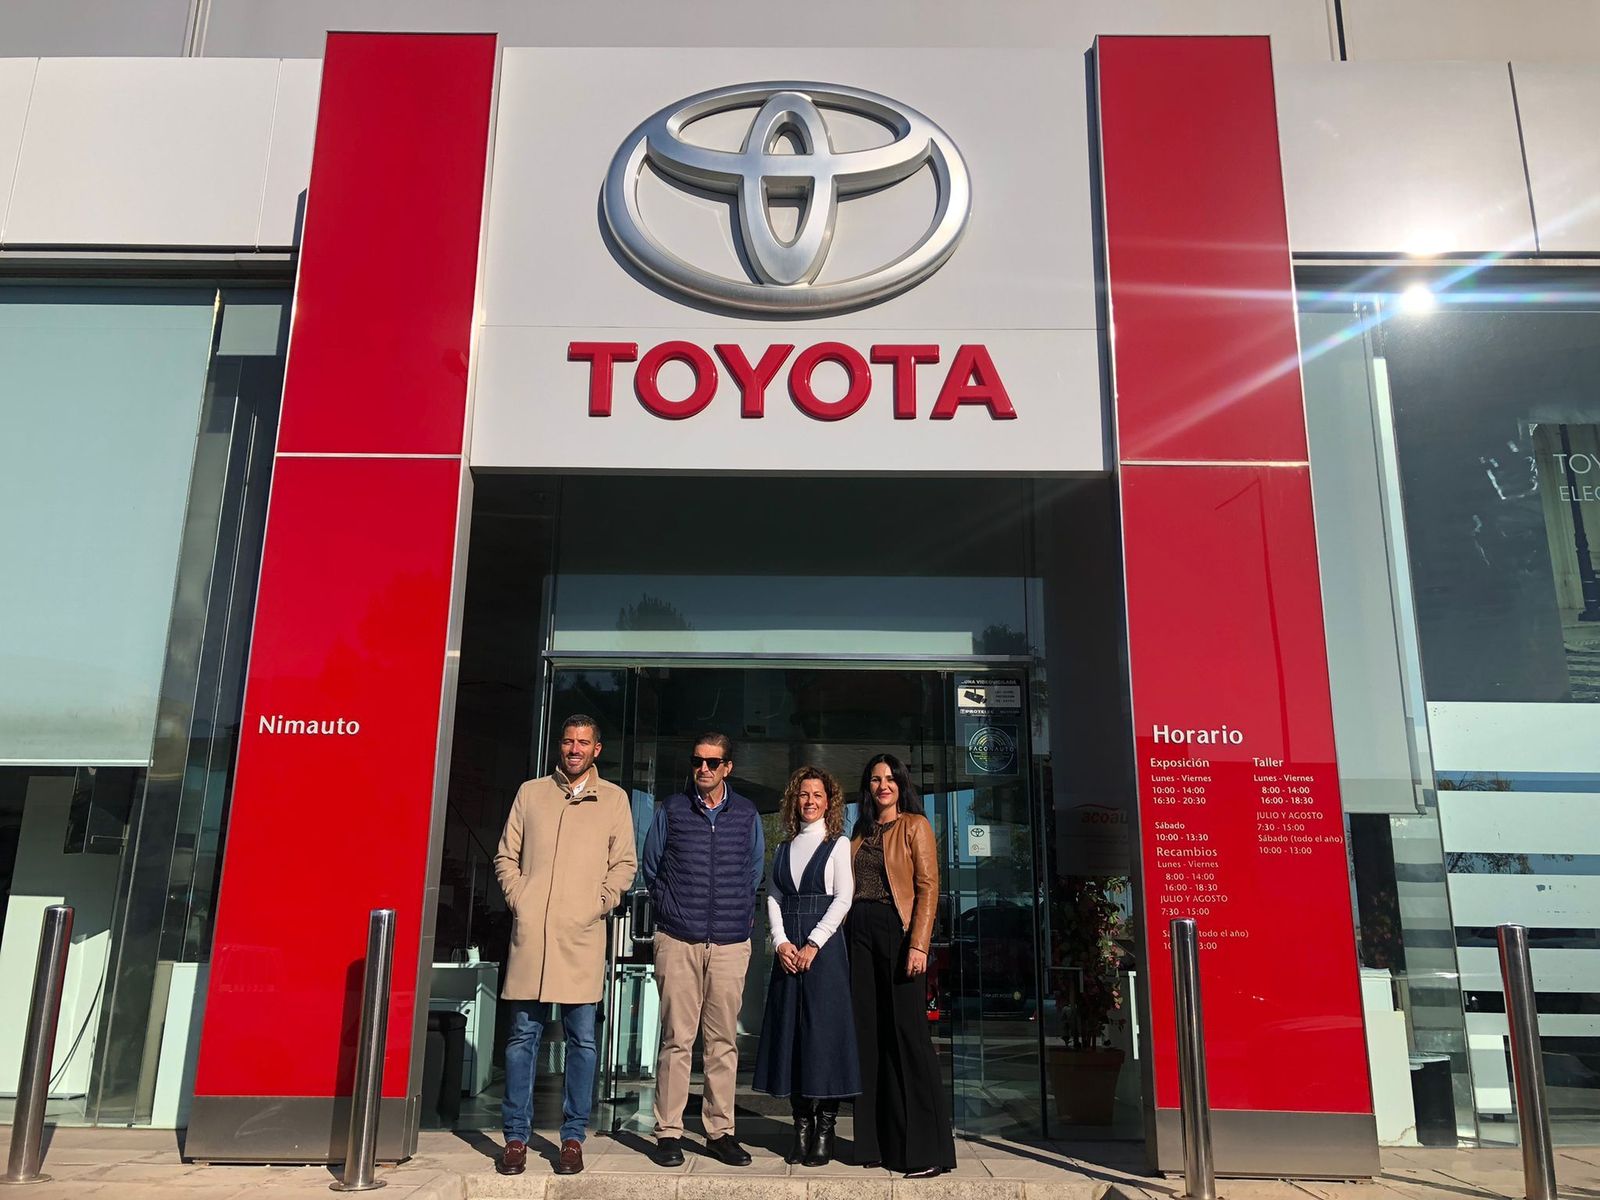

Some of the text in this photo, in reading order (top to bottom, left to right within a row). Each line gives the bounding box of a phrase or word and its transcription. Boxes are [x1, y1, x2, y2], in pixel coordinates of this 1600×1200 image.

[568, 340, 1017, 421] TOYOTA
[259, 715, 360, 735] Nimauto
[1153, 724, 1243, 744] Horario
[1150, 757, 1210, 770] Exposición
[1252, 757, 1284, 767] Taller
[1181, 774, 1212, 782] Viernes
[1253, 774, 1277, 782] Lunes
[1283, 774, 1314, 782] Viernes
[1152, 786, 1175, 794] 10:00
[1182, 786, 1205, 794] 14:00
[1262, 786, 1280, 794] 8:00
[1288, 786, 1310, 794] 14:00
[1183, 797, 1206, 805] 20:30
[1291, 796, 1313, 804] 18:30
[1257, 811, 1279, 820] JULIO
[1155, 821, 1185, 829] Sábado
[1257, 823, 1275, 831] 7:30
[1282, 823, 1305, 831] 15:00
[1156, 833, 1179, 841] 10:00
[1186, 833, 1209, 841] 13:30
[1258, 834, 1343, 844] Sábado (todo el año)
[1156, 846, 1217, 857] Recambios
[1259, 846, 1282, 854] 10:00
[1290, 846, 1312, 854] 13:00
[1188, 860, 1219, 868] Viernes
[1165, 873, 1184, 881] 8:00
[1192, 873, 1215, 881] 14:00
[1165, 883, 1188, 891] 16:00
[1195, 884, 1218, 892] 18:30
[1160, 895, 1183, 904] JULIO
[1193, 895, 1228, 903] AGOSTO
[1161, 908, 1179, 916] 7:30
[1187, 907, 1210, 915] 15:00
[1198, 929, 1249, 938] todo el año)
[1199, 942, 1217, 950] 3:00
